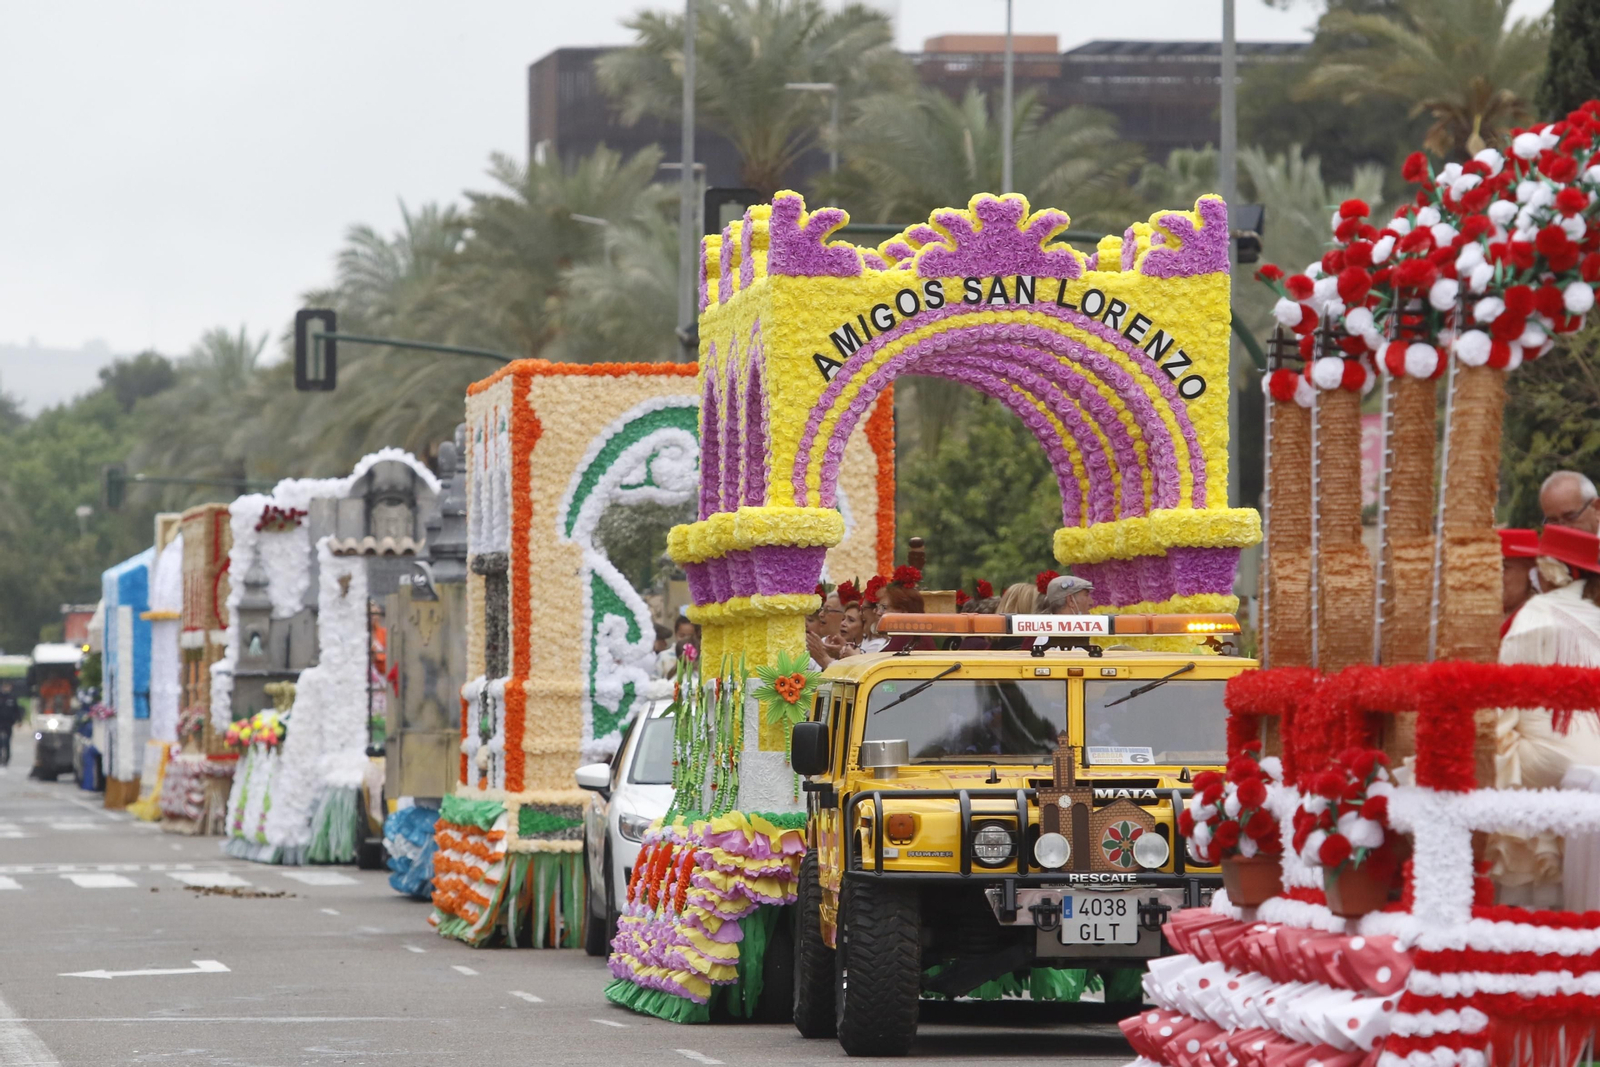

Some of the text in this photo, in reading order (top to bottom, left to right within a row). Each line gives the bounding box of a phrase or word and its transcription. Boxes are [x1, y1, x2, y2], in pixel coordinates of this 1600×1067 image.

[812, 275, 1206, 399] AMIGOS SAN LORENZO
[1018, 621, 1103, 632] GRUAS MATA
[1130, 754, 1150, 764] 6
[1095, 789, 1157, 798] MATA
[1069, 873, 1137, 882] RESCATE
[1079, 898, 1127, 916] 4038
[1080, 923, 1120, 941] GLT
